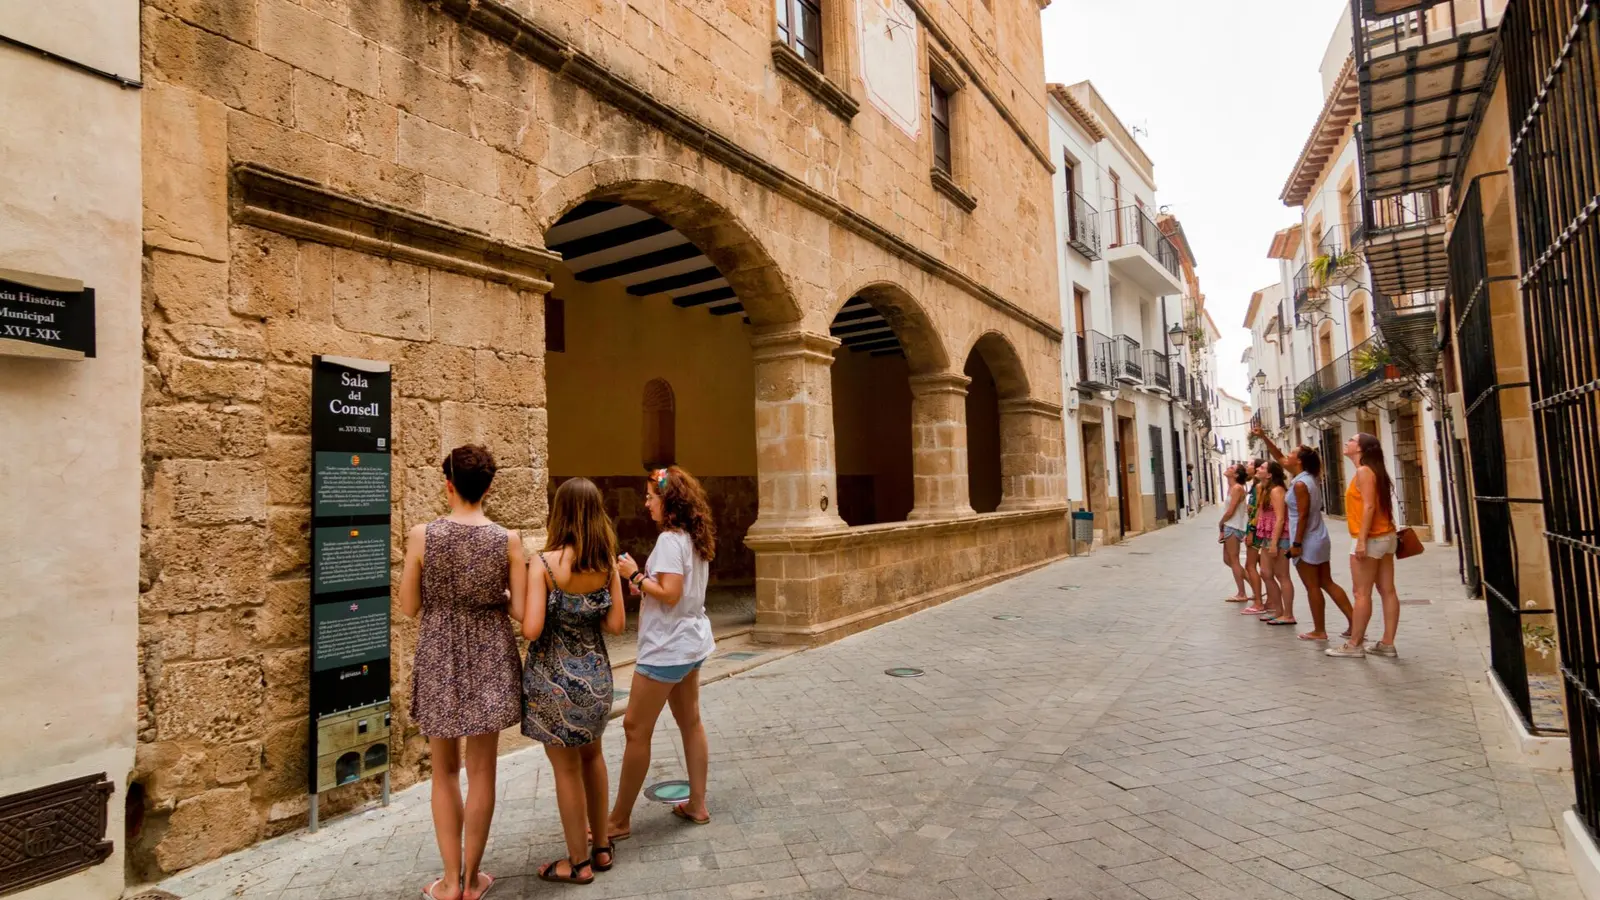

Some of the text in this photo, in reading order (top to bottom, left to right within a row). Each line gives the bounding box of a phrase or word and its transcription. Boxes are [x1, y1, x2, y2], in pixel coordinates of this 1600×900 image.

[4, 325, 61, 340] XVI-XIX
[341, 372, 368, 388] Sala
[348, 391, 361, 400] del
[329, 399, 379, 416] Consell
